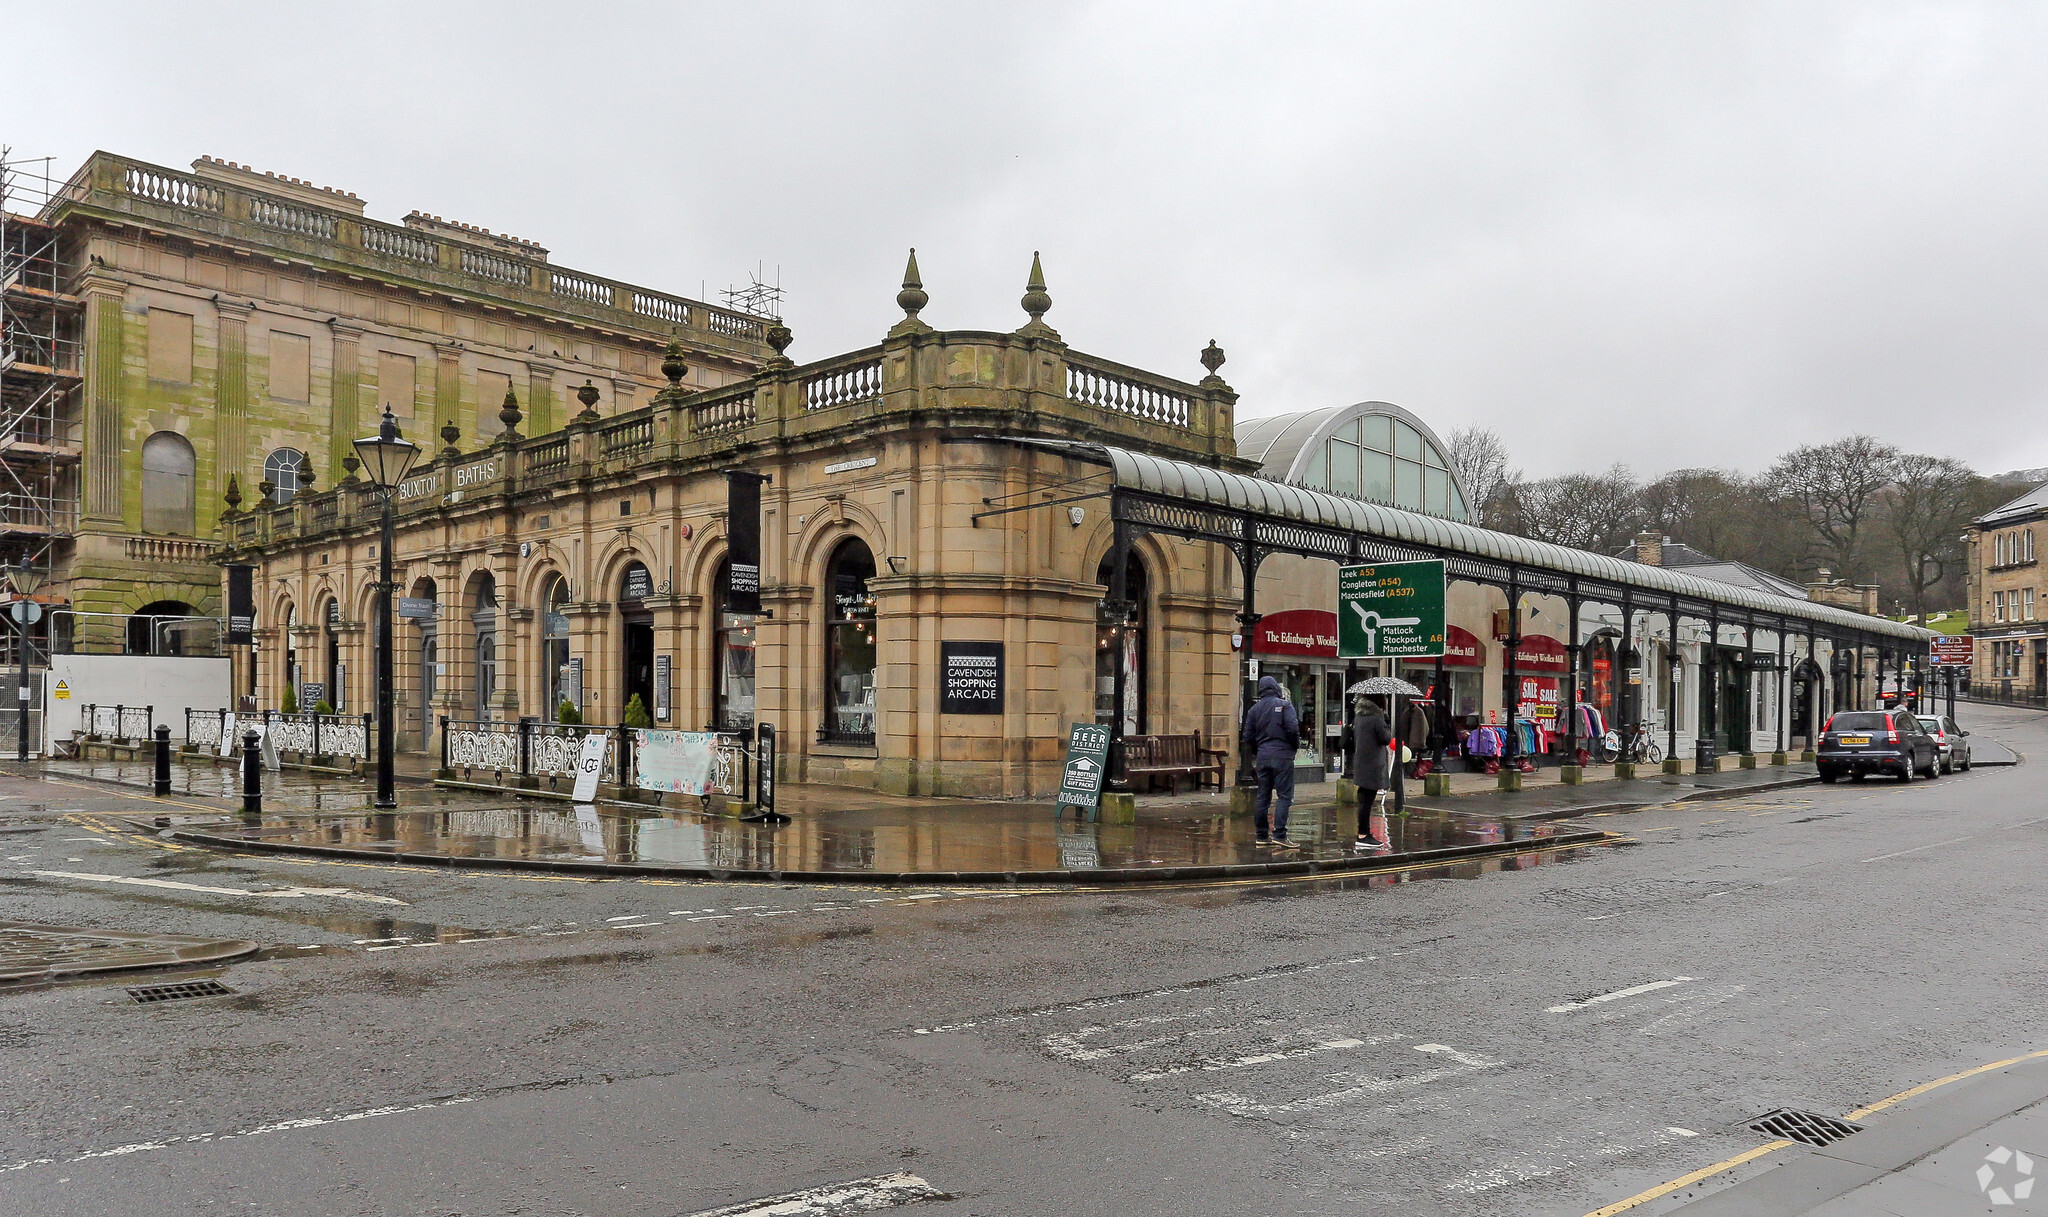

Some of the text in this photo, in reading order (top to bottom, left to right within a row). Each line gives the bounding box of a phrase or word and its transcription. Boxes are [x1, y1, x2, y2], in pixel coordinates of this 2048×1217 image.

[457, 462, 495, 487] BATHS
[731, 571, 758, 579] CAVENDISH
[1341, 568, 1375, 578] Leek A53
[1341, 577, 1401, 589] Congleton (A54)
[1341, 588, 1415, 600] Macclesfield (A537)
[1266, 631, 1338, 648] The Edinburgh Woolle
[1383, 634, 1443, 644] Stockport A6
[1383, 645, 1428, 653] Manchester
[1465, 647, 1475, 656] Mill
[1518, 652, 1564, 664] Edinburgh Woollen Mill
[948, 668, 996, 677] CAVENDISH
[948, 679, 996, 688] SHOPPING
[948, 689, 996, 699] ARCADE
[1522, 682, 1538, 698] SALE
[1540, 688, 1557, 702] SALE
[1073, 731, 1106, 744] BEER
[1071, 740, 1105, 750] DISTRICT
[581, 758, 598, 773] UGG
[1077, 770, 1098, 779] BOTTLES
